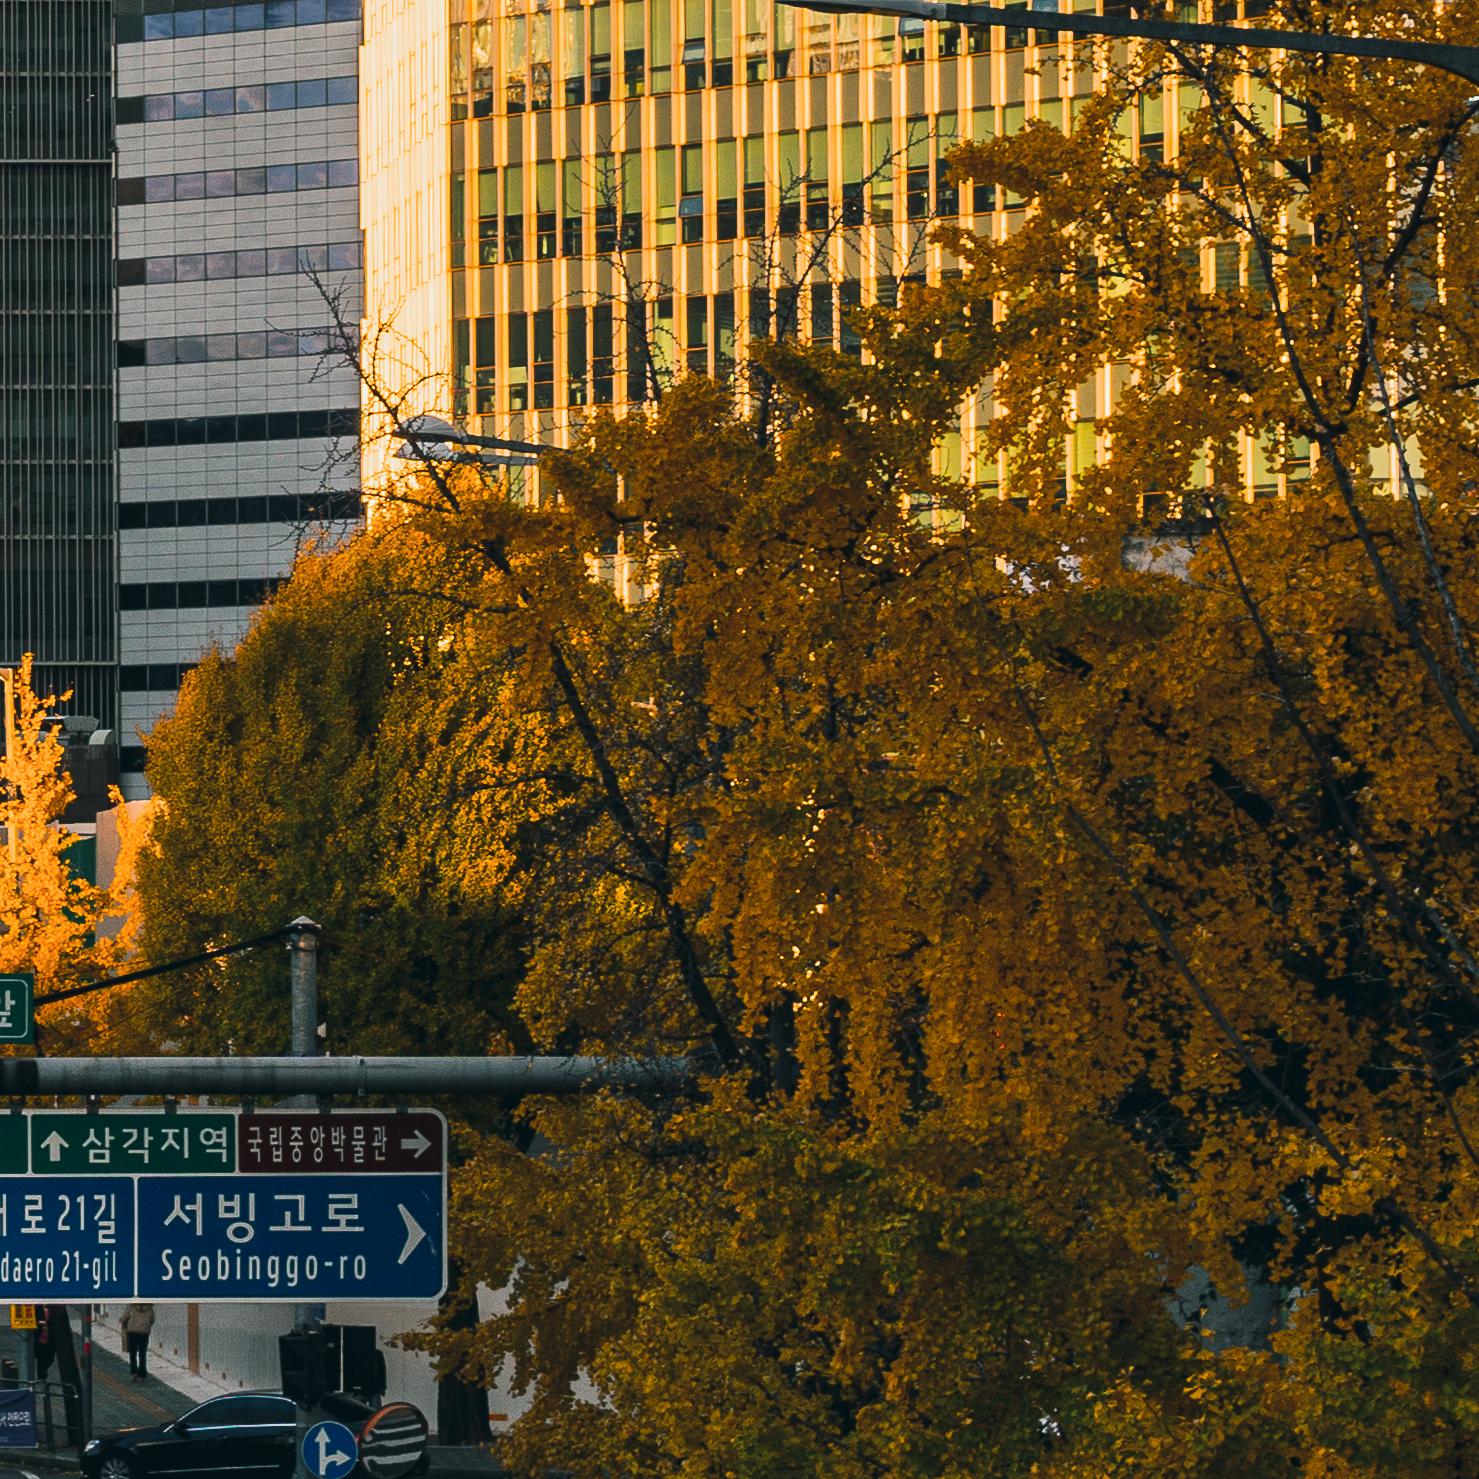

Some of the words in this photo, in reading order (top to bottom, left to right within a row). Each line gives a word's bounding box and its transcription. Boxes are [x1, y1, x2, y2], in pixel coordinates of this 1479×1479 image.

[82, 1126, 227, 1164] 삼각지역
[247, 1125, 388, 1164] 국립중앙박물관
[163, 1192, 365, 1243] 서빙고로
[61, 1250, 117, 1289] 21-gil
[161, 1249, 367, 1287] Seobinggo-ro
